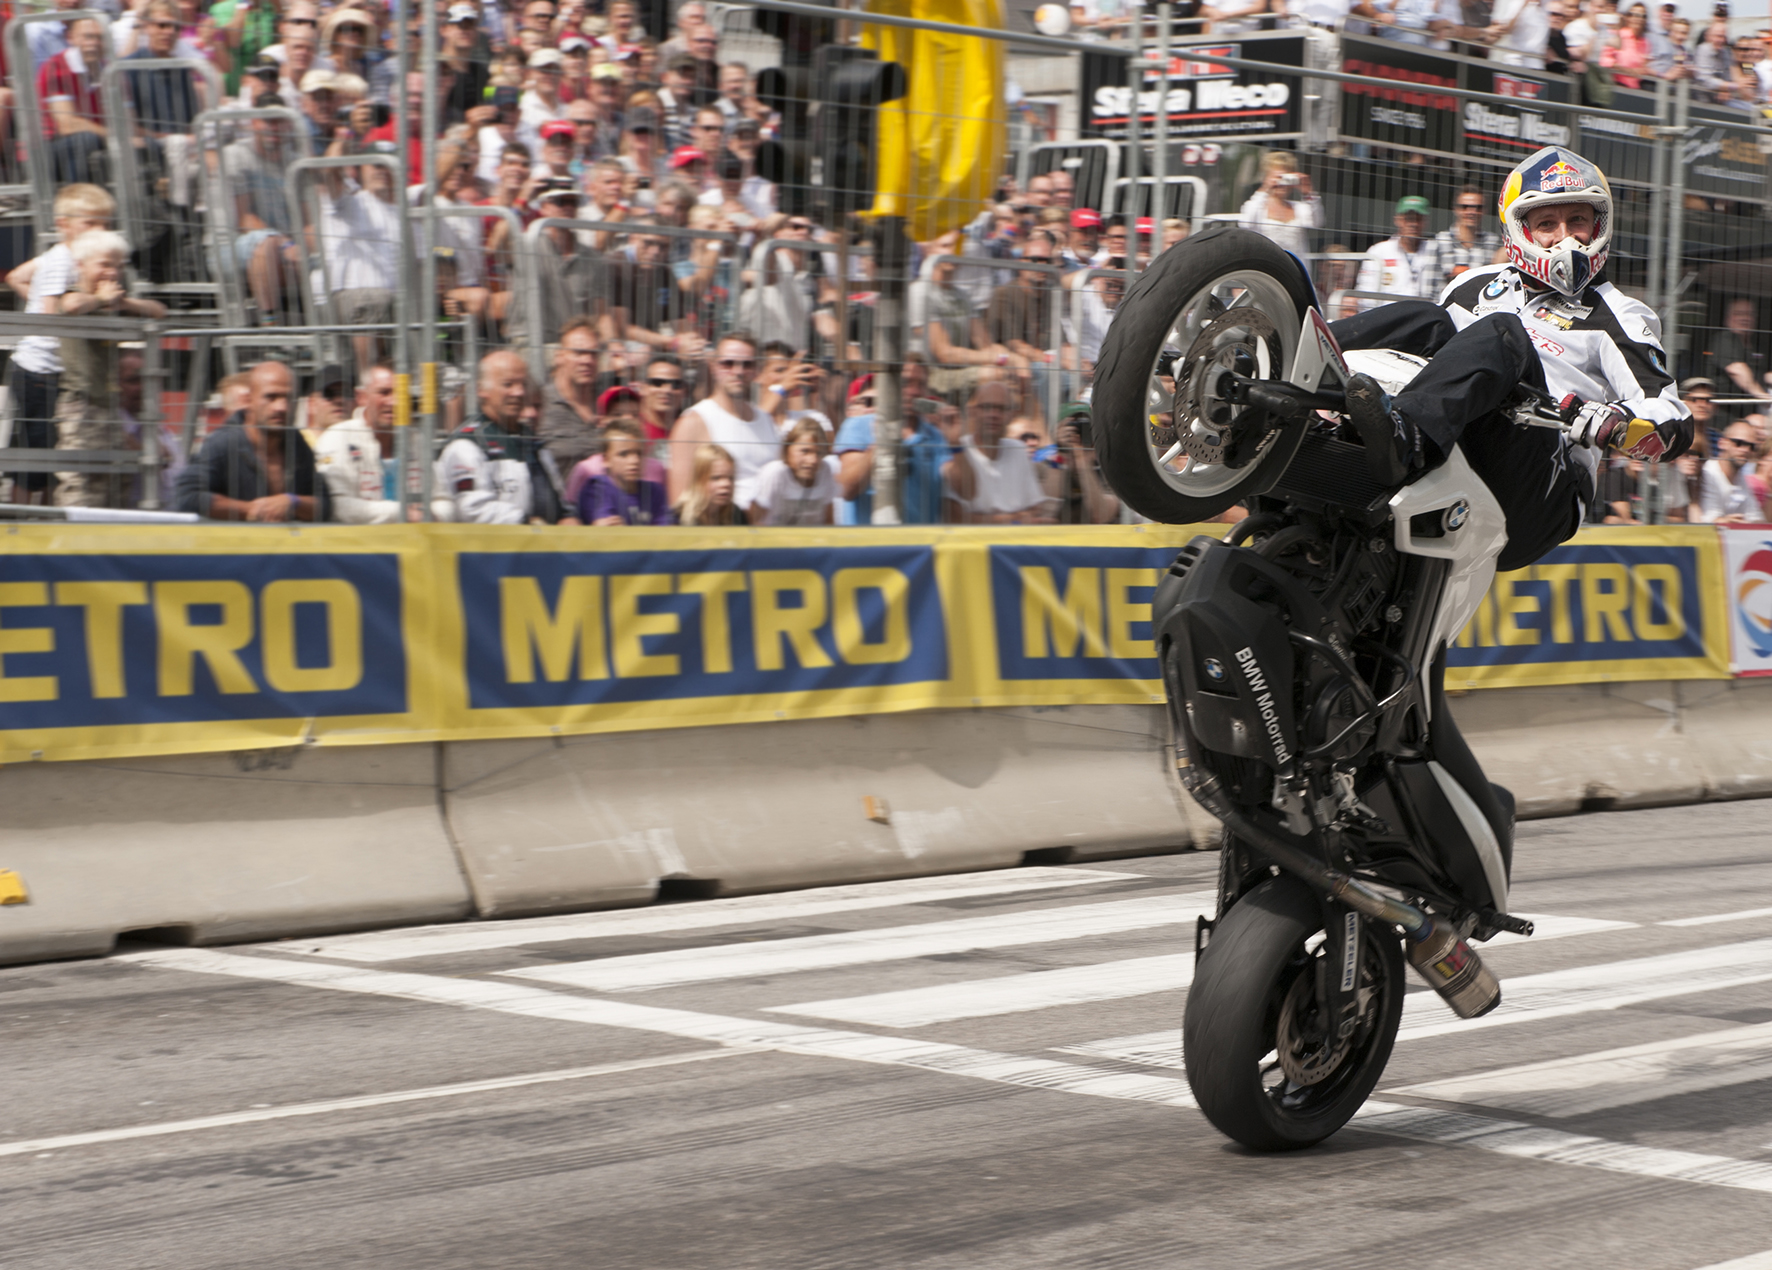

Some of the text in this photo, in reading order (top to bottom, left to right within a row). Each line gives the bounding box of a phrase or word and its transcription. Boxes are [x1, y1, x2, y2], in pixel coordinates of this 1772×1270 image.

[1541, 176, 1563, 191] Red
[1565, 176, 1585, 188] Bull
[499, 567, 912, 683] METRO
[1235, 646, 1292, 765] BMW Motorrad
